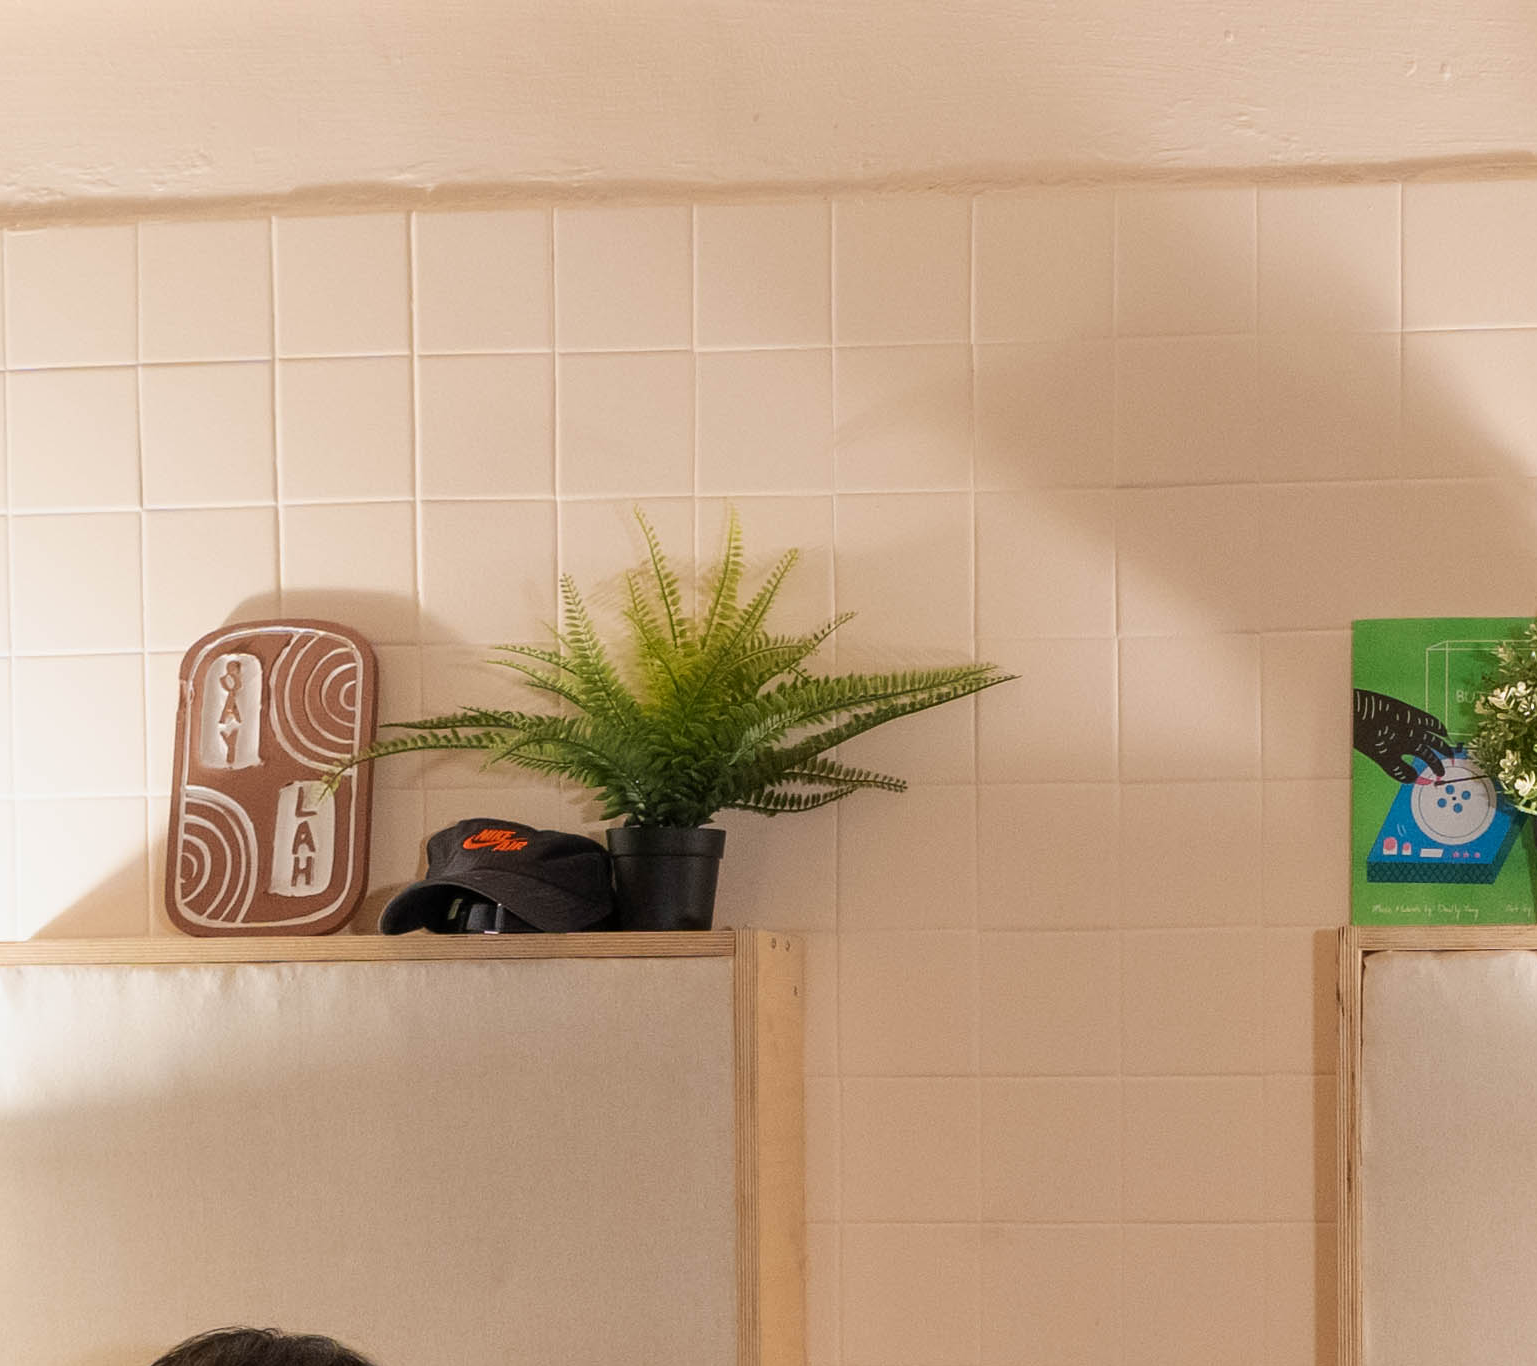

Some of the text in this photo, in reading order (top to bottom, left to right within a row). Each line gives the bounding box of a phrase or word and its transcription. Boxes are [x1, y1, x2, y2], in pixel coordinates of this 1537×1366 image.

[219, 660, 242, 764] SAY
[291, 786, 318, 888] LAH
[472, 828, 516, 842] NIKE
[492, 839, 527, 852] AIR
